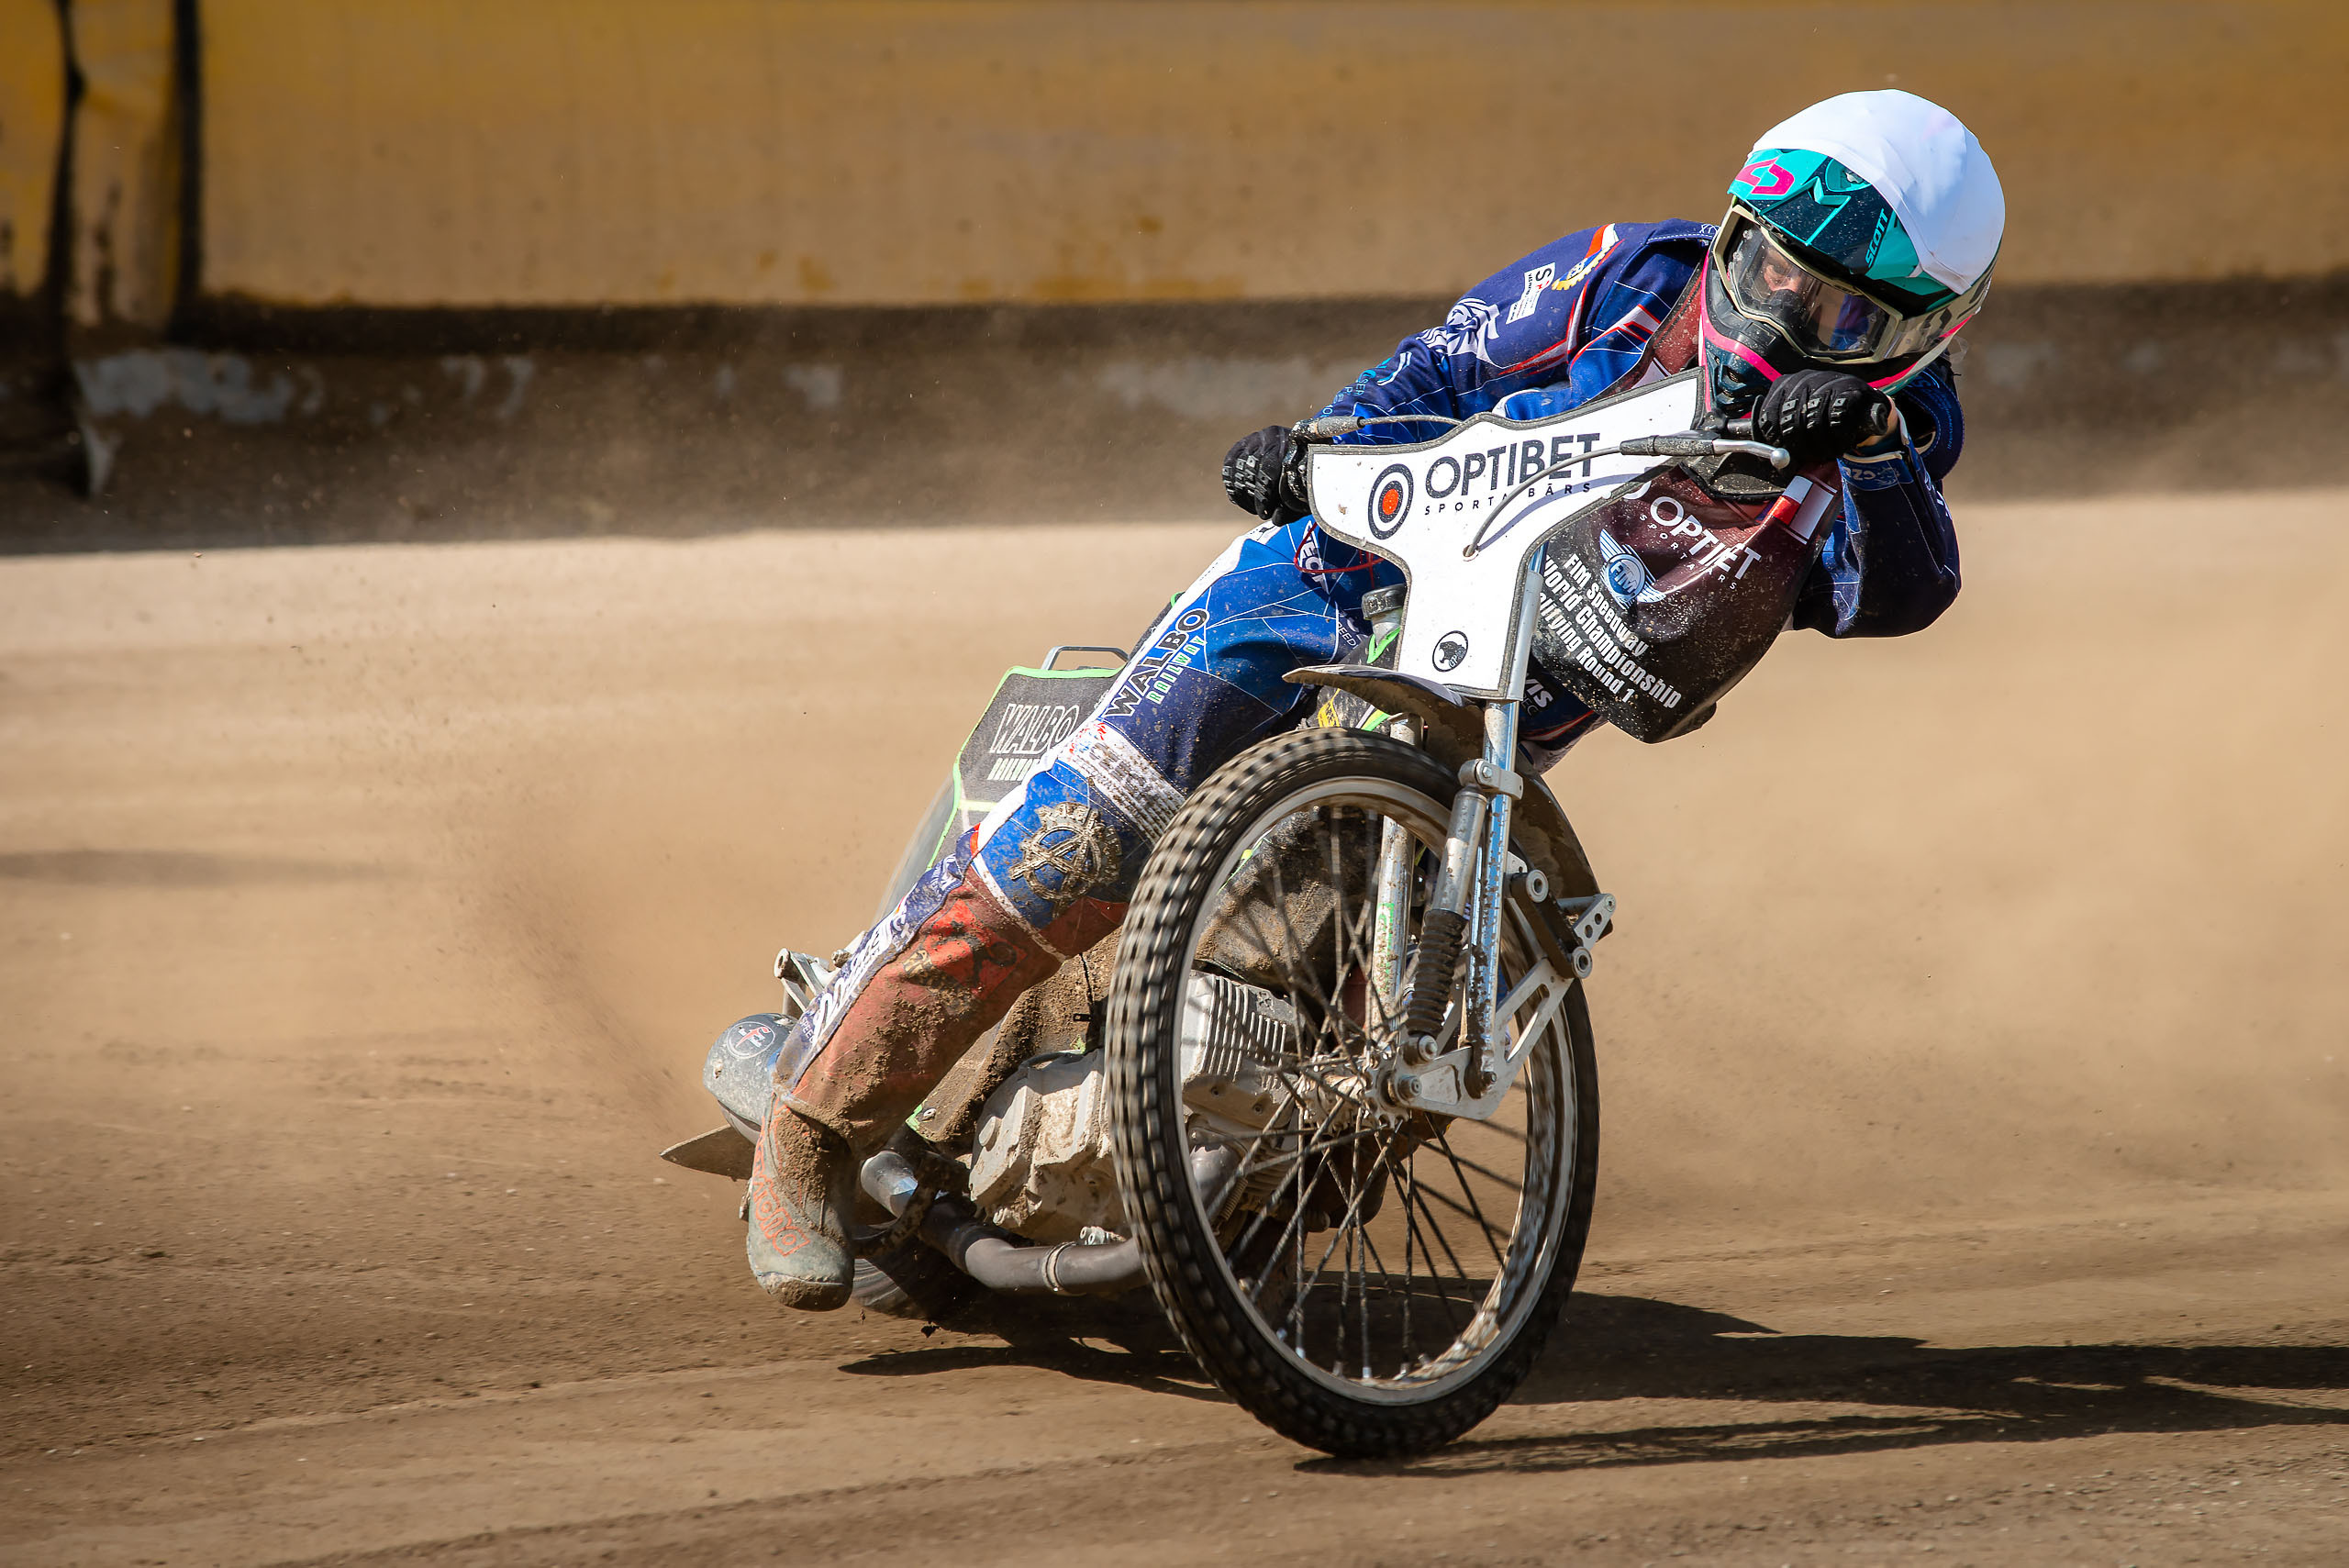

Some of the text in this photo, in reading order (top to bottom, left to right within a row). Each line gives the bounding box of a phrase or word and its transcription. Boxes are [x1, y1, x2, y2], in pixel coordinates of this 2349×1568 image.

[1865, 207, 1889, 268] SCOTT
[1425, 432, 1601, 499] OPTIBET
[1528, 483, 1591, 498] BĀRS
[1639, 513, 1696, 571] SPORTA
[1564, 553, 1650, 657] FIM Speedway
[1609, 561, 1638, 595] FIM
[1103, 607, 1210, 717] WALBO
[1145, 635, 1208, 706] RAILWAY
[1575, 606, 1682, 709] Championship
[1575, 645, 1625, 695] Round
[1622, 688, 1635, 704] 1
